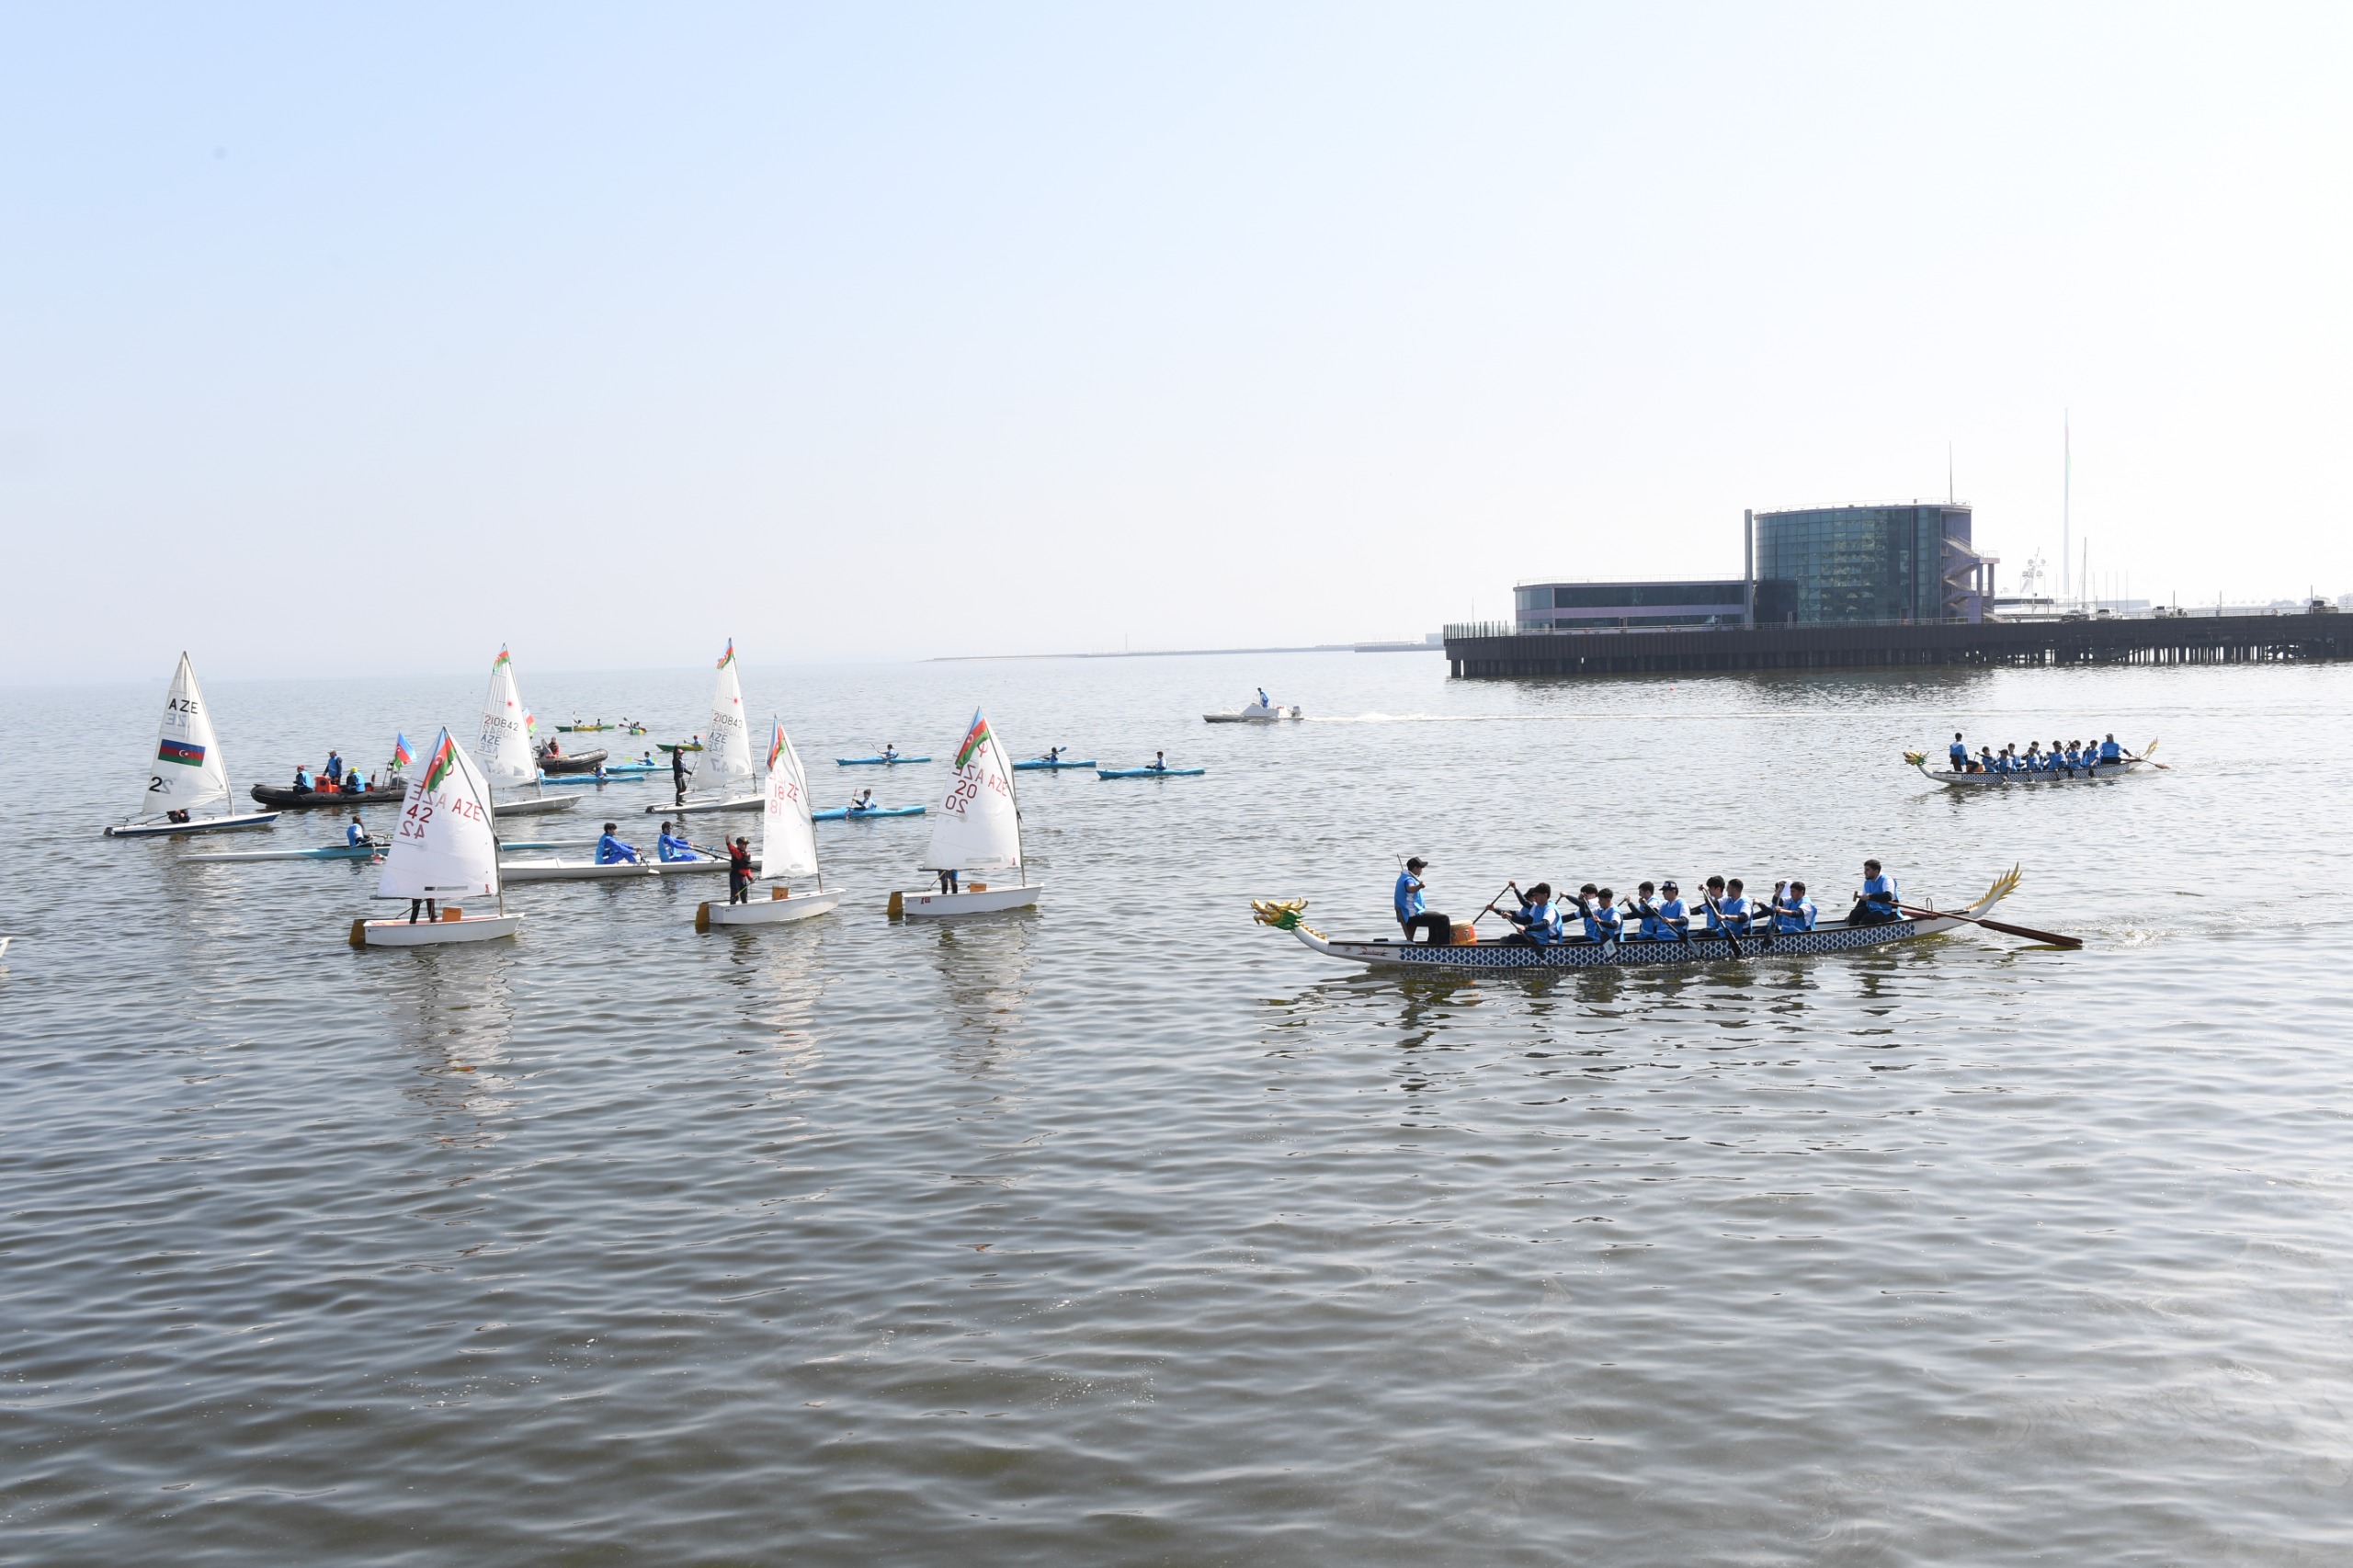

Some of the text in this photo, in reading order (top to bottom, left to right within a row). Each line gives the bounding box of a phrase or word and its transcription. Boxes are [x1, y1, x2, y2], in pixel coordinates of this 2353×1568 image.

[168, 699, 198, 714] AZE
[484, 715, 518, 732] 210842
[481, 733, 501, 746] AZE
[709, 731, 728, 744] AZE
[149, 777, 163, 792] 2
[775, 783, 785, 800] 18
[955, 779, 977, 799] 20
[988, 774, 1007, 797] AZE
[406, 803, 433, 824] 42
[451, 798, 482, 822] AZE
